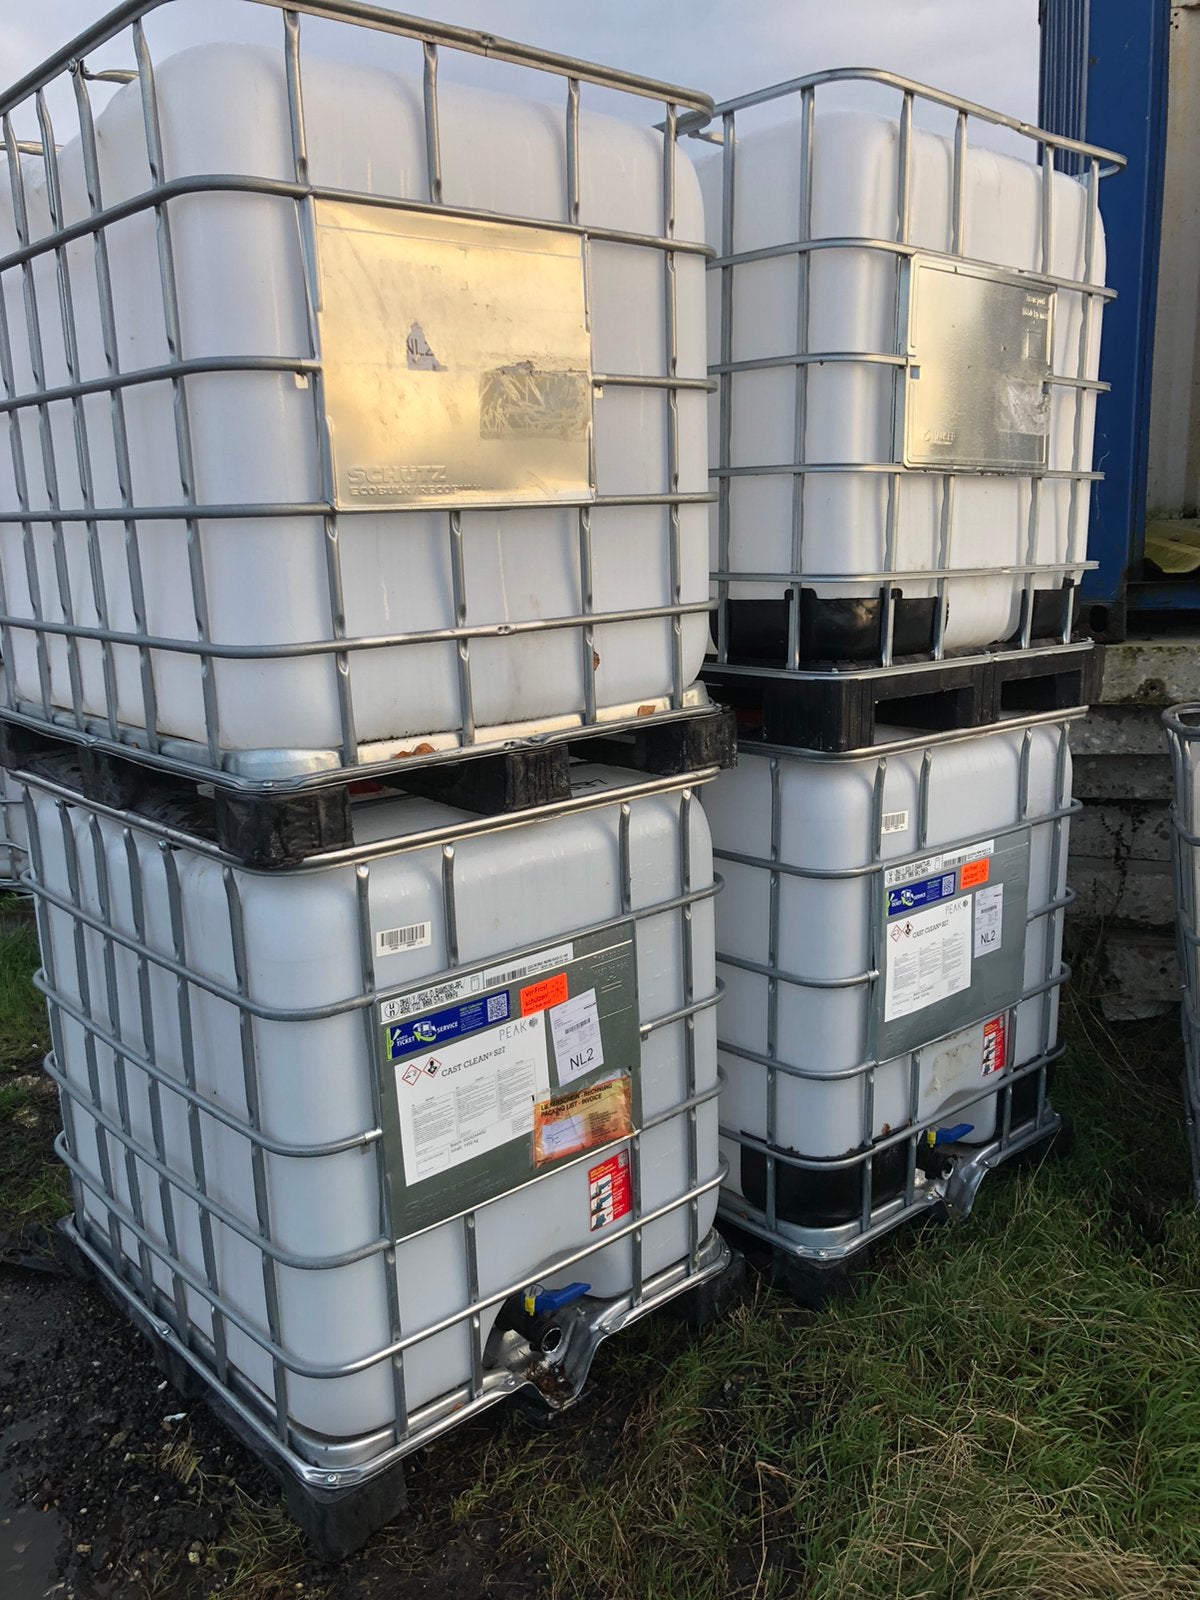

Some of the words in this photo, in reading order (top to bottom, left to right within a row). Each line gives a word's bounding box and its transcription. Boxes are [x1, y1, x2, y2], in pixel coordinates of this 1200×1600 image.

[348, 465, 446, 484] SCHÜTZ
[980, 929, 996, 945] NL2
[396, 1036, 416, 1047] TICKET
[437, 1021, 459, 1034] SERVICE
[499, 1020, 527, 1041] PEAK
[441, 1064, 462, 1077] CAST
[493, 1046, 506, 1057] S27
[570, 1047, 594, 1070] NL2
[584, 1083, 613, 1097] RECHNUNG
[540, 1106, 566, 1118] PACKING
[566, 1101, 578, 1111] LIST
[581, 1093, 602, 1105] INVOICE
